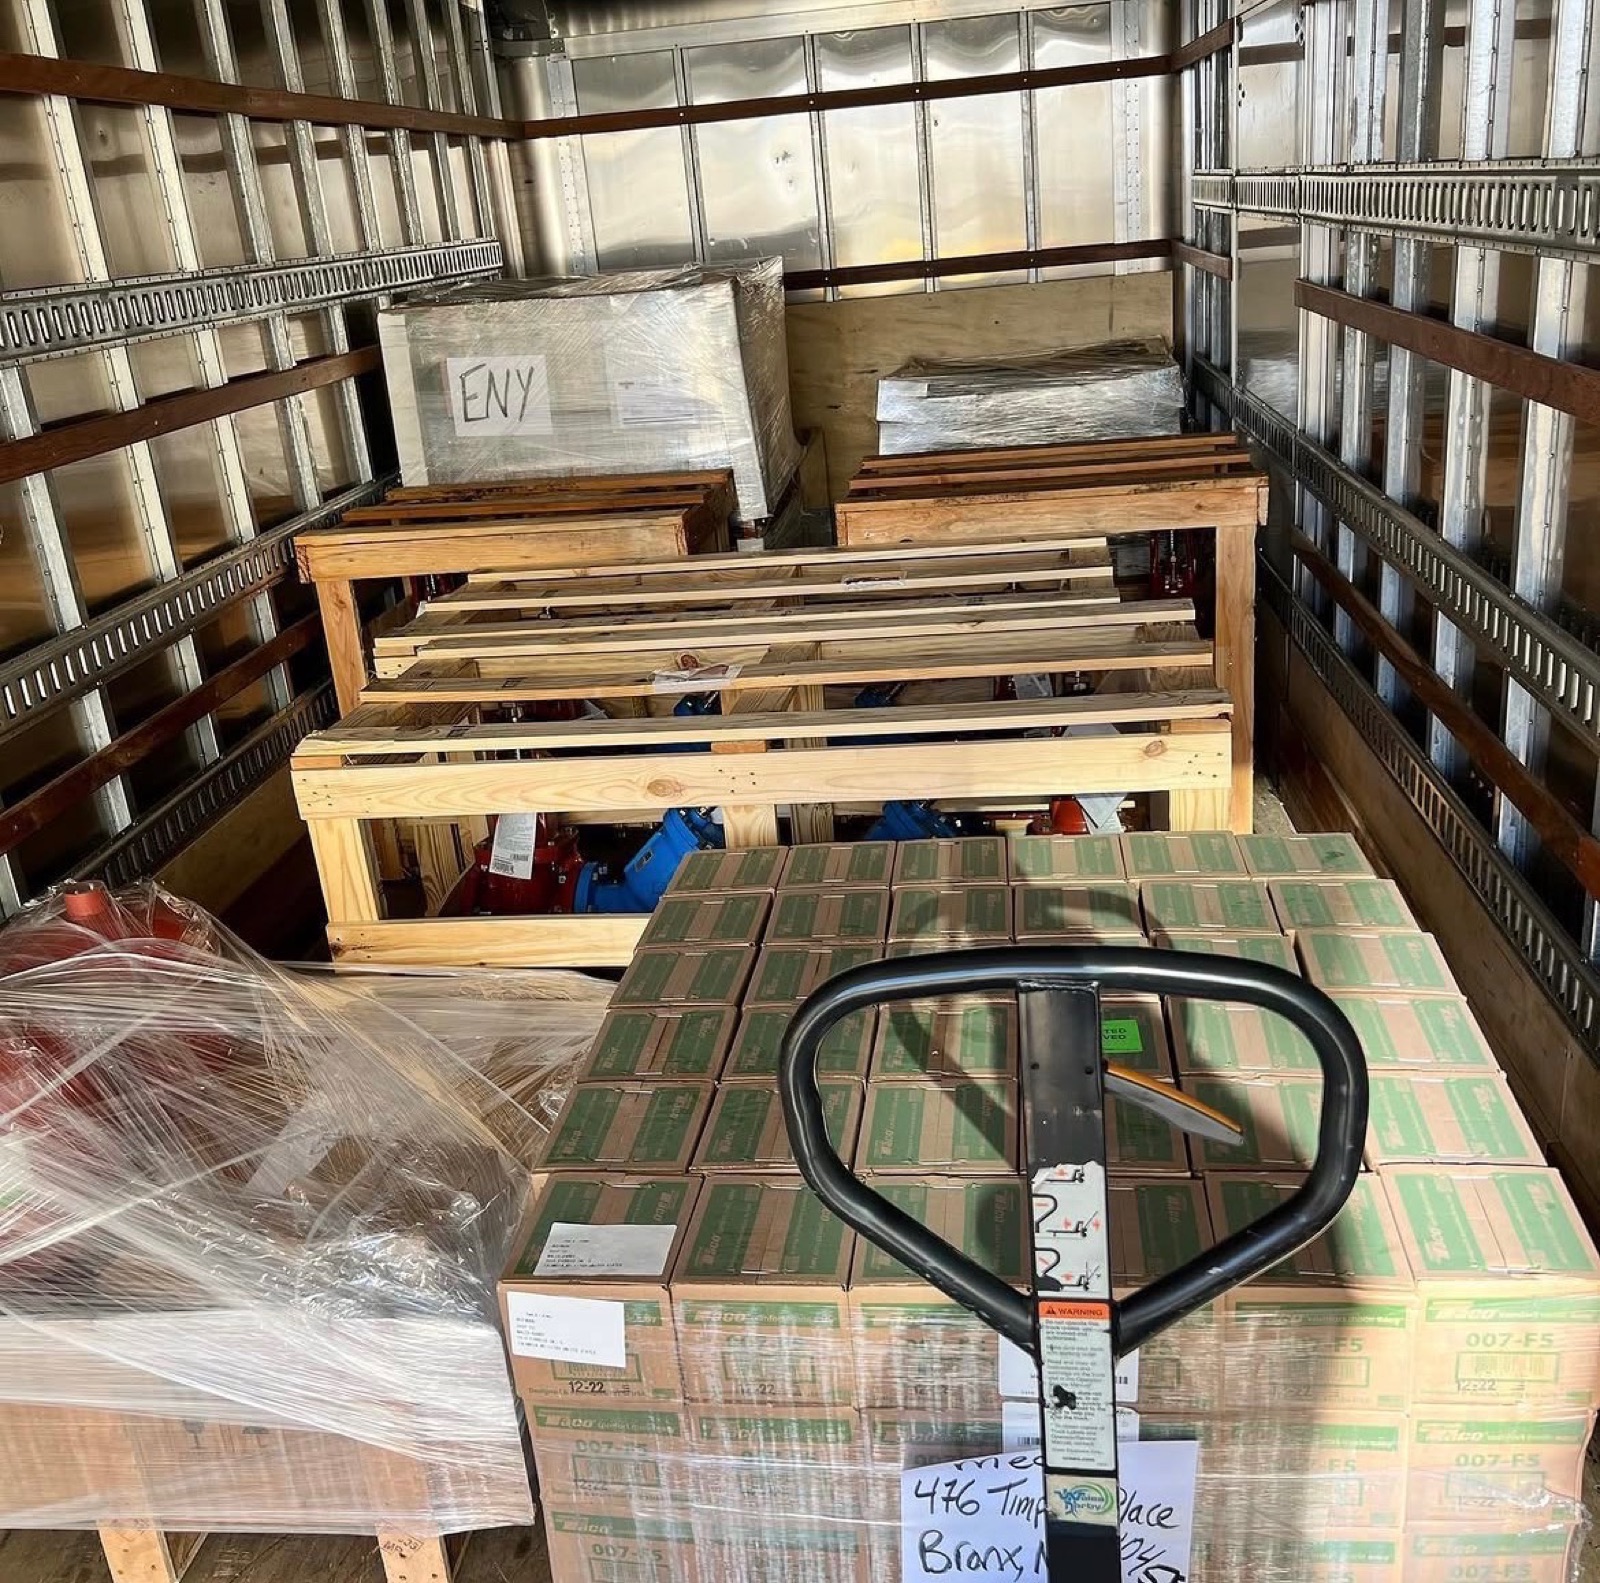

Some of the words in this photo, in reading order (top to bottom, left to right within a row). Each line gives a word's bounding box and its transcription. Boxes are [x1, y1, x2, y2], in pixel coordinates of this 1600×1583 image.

[459, 363, 534, 423] ENY
[1103, 1027, 1127, 1035] TED
[1058, 1307, 1103, 1316] WARNING
[1465, 1332, 1555, 1349] 007-F5
[568, 1381, 606, 1394] 12-22
[1455, 1453, 1541, 1467] 007-F5
[914, 1476, 980, 1516] 476
[986, 1477, 1047, 1529] Timp
